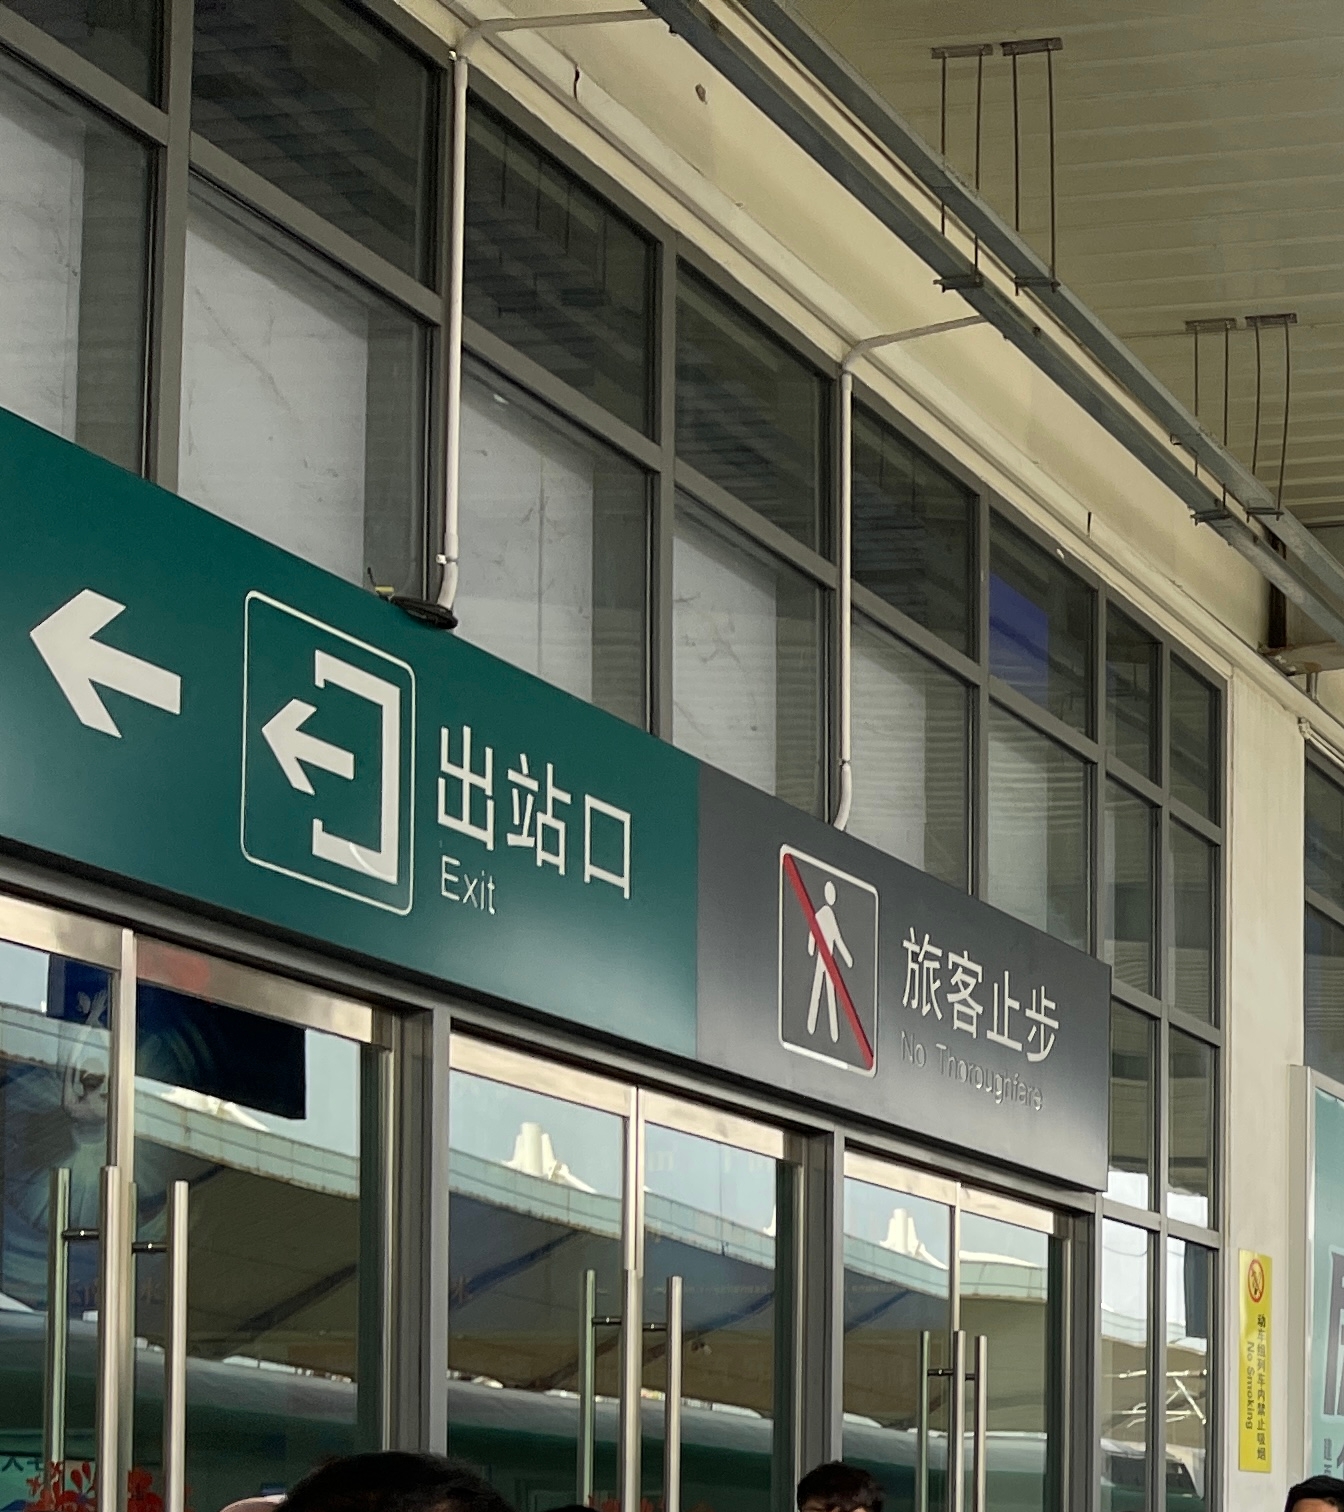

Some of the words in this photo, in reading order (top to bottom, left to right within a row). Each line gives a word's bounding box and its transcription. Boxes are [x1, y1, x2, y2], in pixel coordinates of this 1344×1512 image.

[436, 725, 633, 899] 出站口
[440, 855, 497, 916] Exit
[901, 927, 1060, 1064] 旅客止步
[900, 1030, 927, 1068] No
[936, 1043, 1044, 1112] Thoroughfare
[1246, 1341, 1255, 1362] No
[1256, 1313, 1267, 1461] 动车组列车内禁止吸烟
[1245, 1366, 1256, 1430] Smoking
